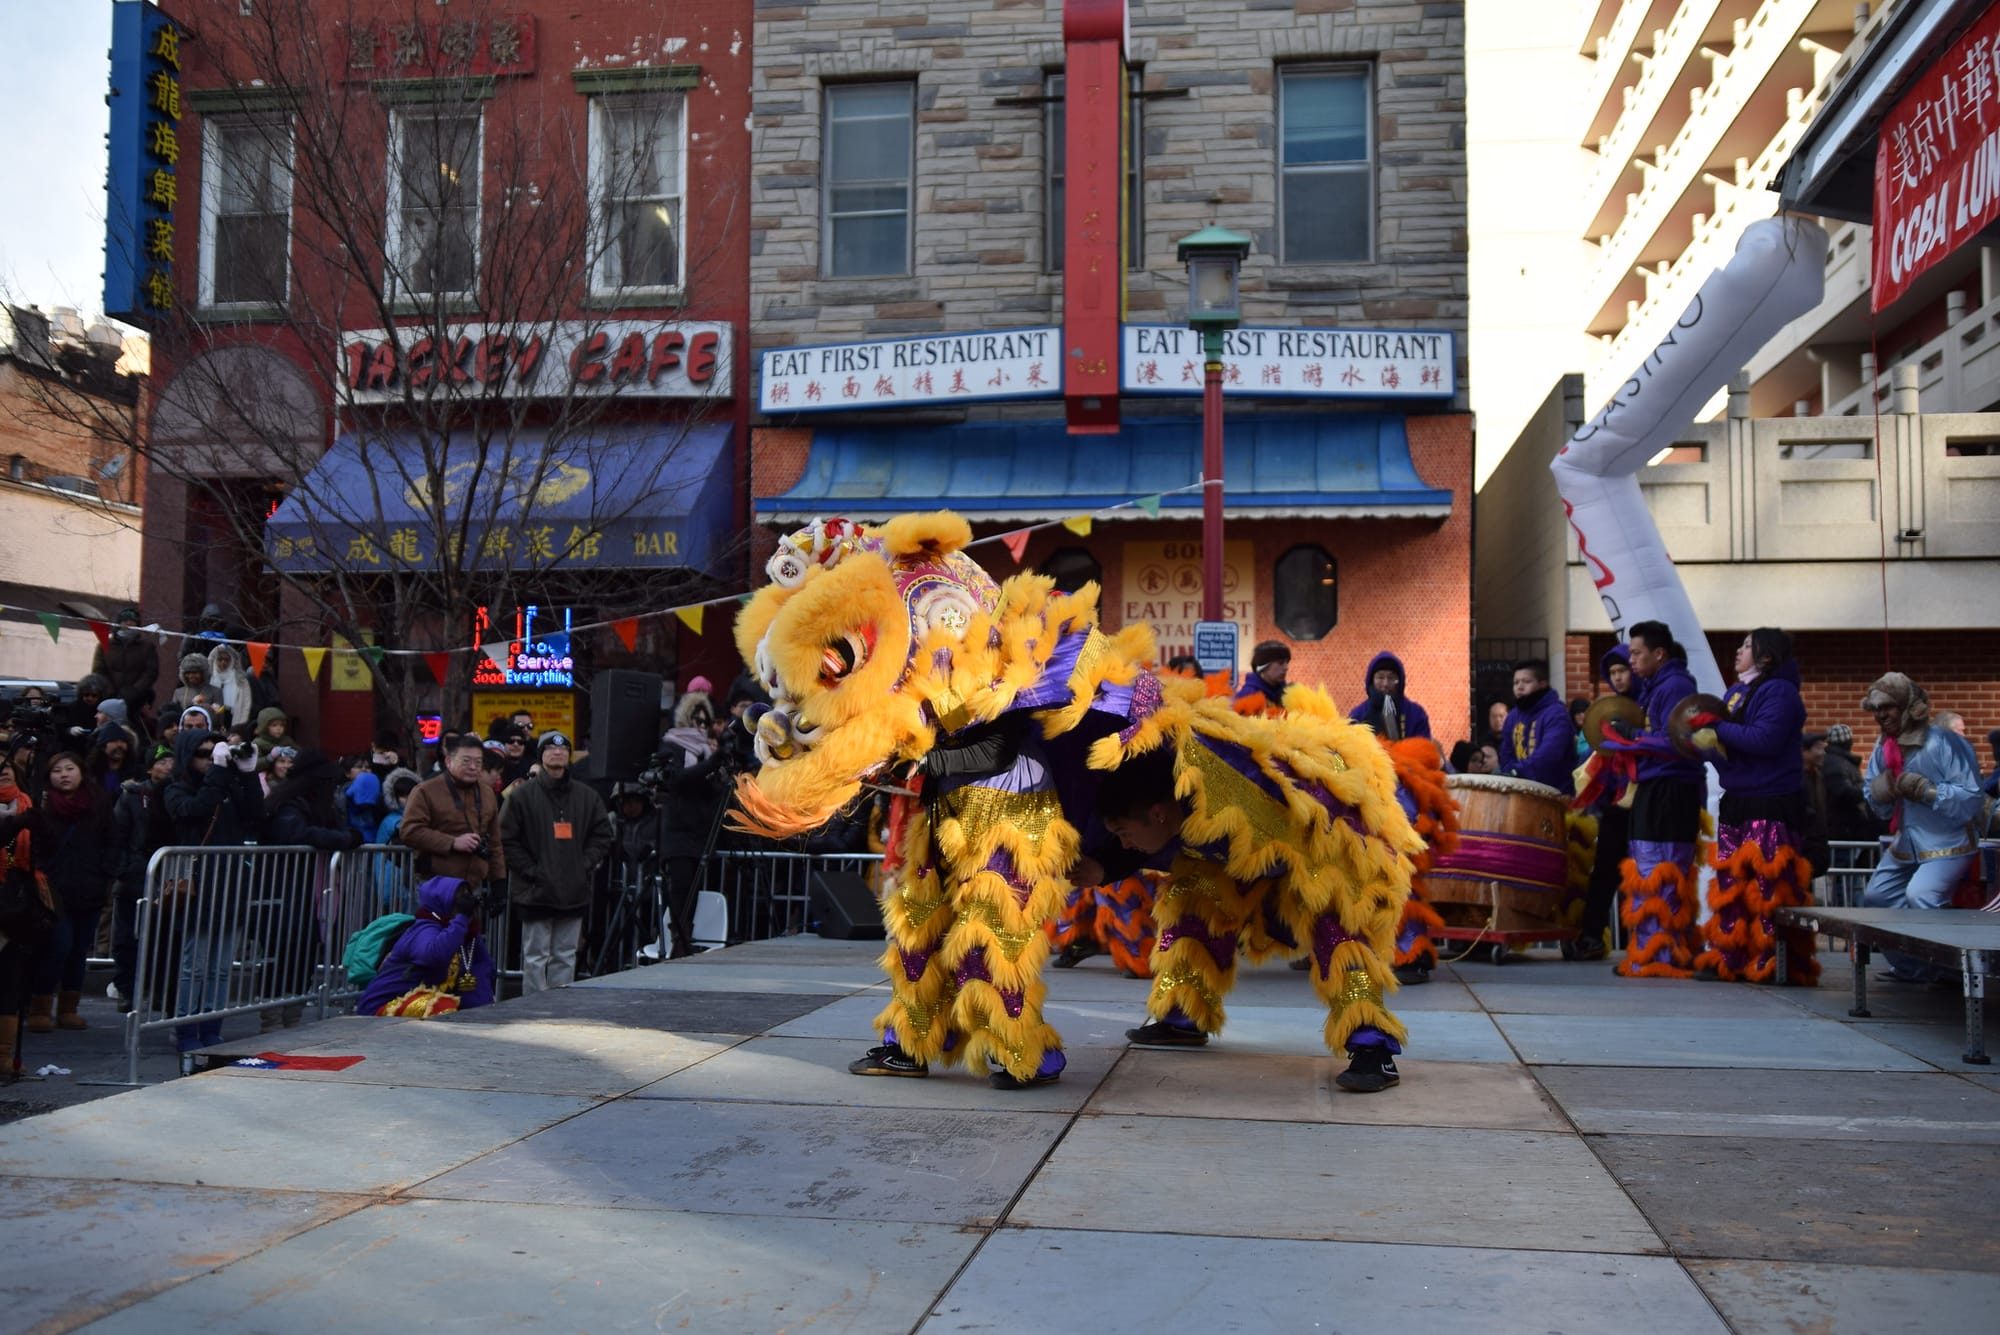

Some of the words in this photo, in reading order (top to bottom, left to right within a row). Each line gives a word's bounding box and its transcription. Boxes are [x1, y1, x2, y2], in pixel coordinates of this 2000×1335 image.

[150, 24, 182, 309] 成龍海鮮菜館
[1890, 181, 1950, 284] CCBA
[570, 331, 719, 382] CAFE
[771, 350, 812, 377] EAT
[821, 345, 883, 373] FIRST
[893, 332, 1049, 368] RESTAURANT
[1136, 329, 1184, 354] EAT
[1196, 329, 1267, 356] FRST
[1277, 331, 1442, 360] RESTAURANT
[634, 531, 679, 556] BAR
[1126, 601, 1172, 619] EAT
[1183, 601, 1253, 618] FIST
[518, 654, 573, 669] Service
[506, 669, 573, 687] Everything
